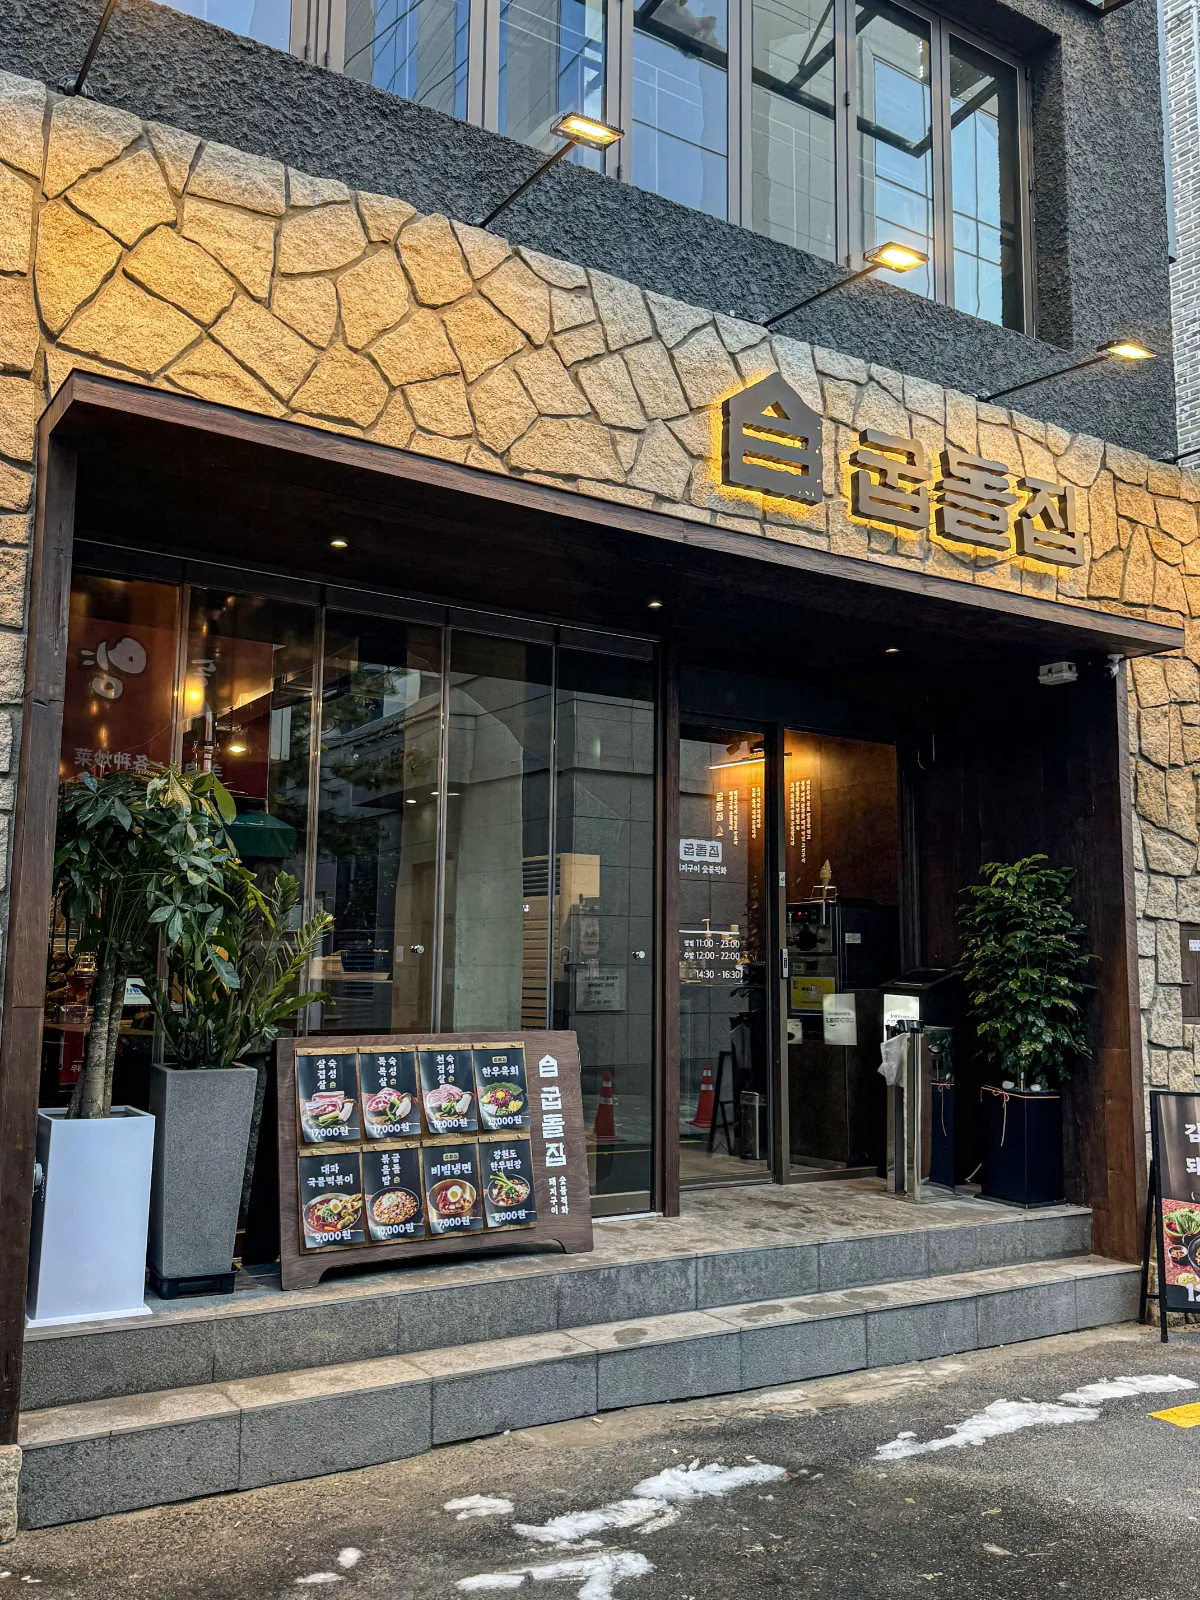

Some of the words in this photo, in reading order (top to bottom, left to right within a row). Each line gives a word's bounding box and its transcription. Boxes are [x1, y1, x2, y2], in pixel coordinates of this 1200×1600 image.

[848, 428, 1085, 568] 굽돌집
[684, 843, 720, 858] 굽돌집
[679, 863, 700, 873] 지구이
[696, 940, 713, 948] 11:00
[696, 952, 714, 960] 12:00
[695, 970, 715, 979] 14:30
[723, 970, 740, 979] 16:30
[328, 1059, 337, 1079] 숙성
[388, 1056, 397, 1076] 숙성
[436, 1054, 445, 1084] 천겹살
[446, 1054, 455, 1074] 숙성
[317, 1059, 327, 1090] 삼겹살
[482, 1065, 519, 1078] 한우육회
[488, 1114, 522, 1127] 25,000원
[540, 1085, 567, 1168] 굽돌집
[311, 1126, 349, 1138] 17,000원
[373, 1122, 411, 1136] 17,000원
[493, 1149, 518, 1160] 강원도
[320, 1163, 340, 1174] 대파
[381, 1154, 391, 1186] 볶음밥
[431, 1162, 472, 1176] 비빔냉면
[490, 1159, 522, 1171] 한우된장
[307, 1174, 354, 1188] 국물떡볶이
[548, 1177, 559, 1215] 돼지구이
[559, 1175, 569, 1214] 숯불직화
[439, 1216, 470, 1228] 7,000원
[494, 1210, 527, 1222] 8,000원
[377, 1222, 415, 1236] 10,000원
[315, 1230, 352, 1244] 9,000원
